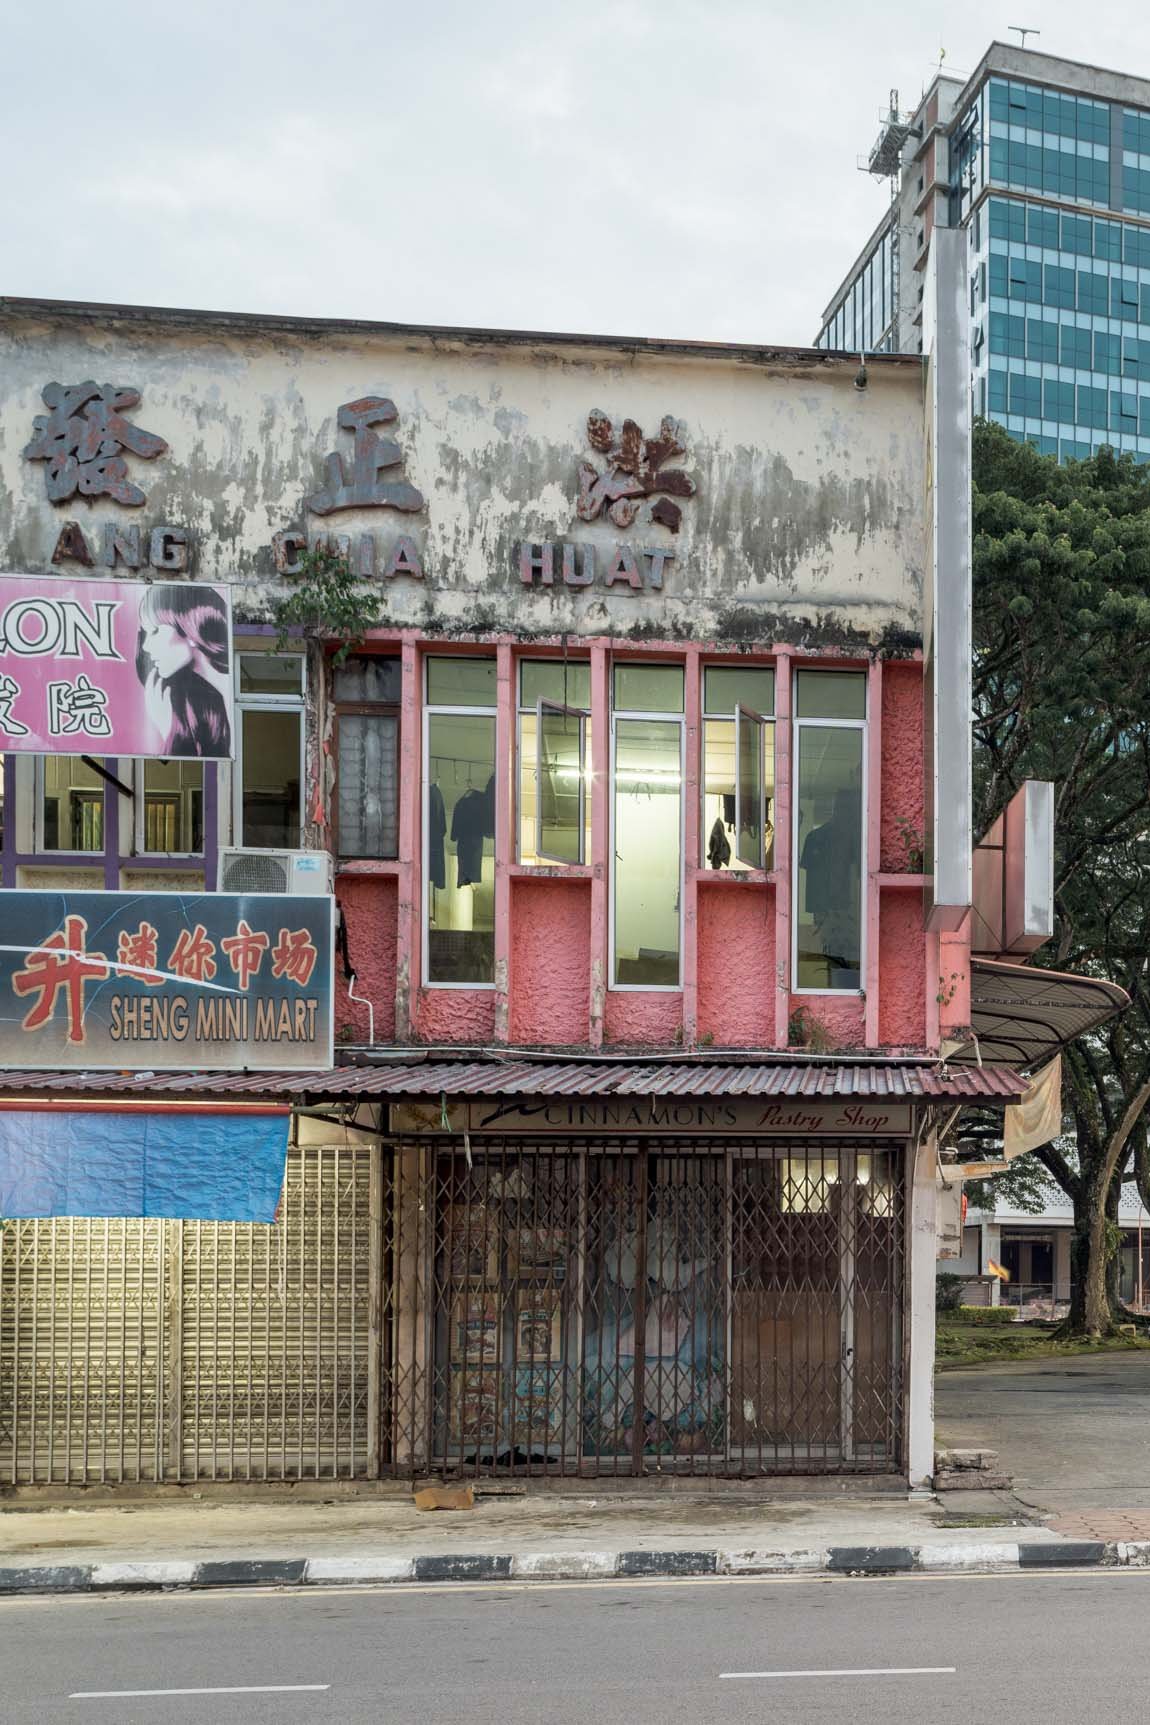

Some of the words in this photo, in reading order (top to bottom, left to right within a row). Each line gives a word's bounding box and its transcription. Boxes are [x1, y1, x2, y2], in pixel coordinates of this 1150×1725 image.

[51, 520, 189, 571] ANG
[519, 542, 675, 589] HUAT
[0, 598, 122, 659] ON
[109, 995, 190, 1042] SHENG
[195, 997, 249, 1042] MINI
[254, 997, 318, 1042] MART
[544, 1103, 737, 1126] CINNAMON'S
[757, 1105, 823, 1131] Pastry
[835, 1105, 889, 1132] Shop
